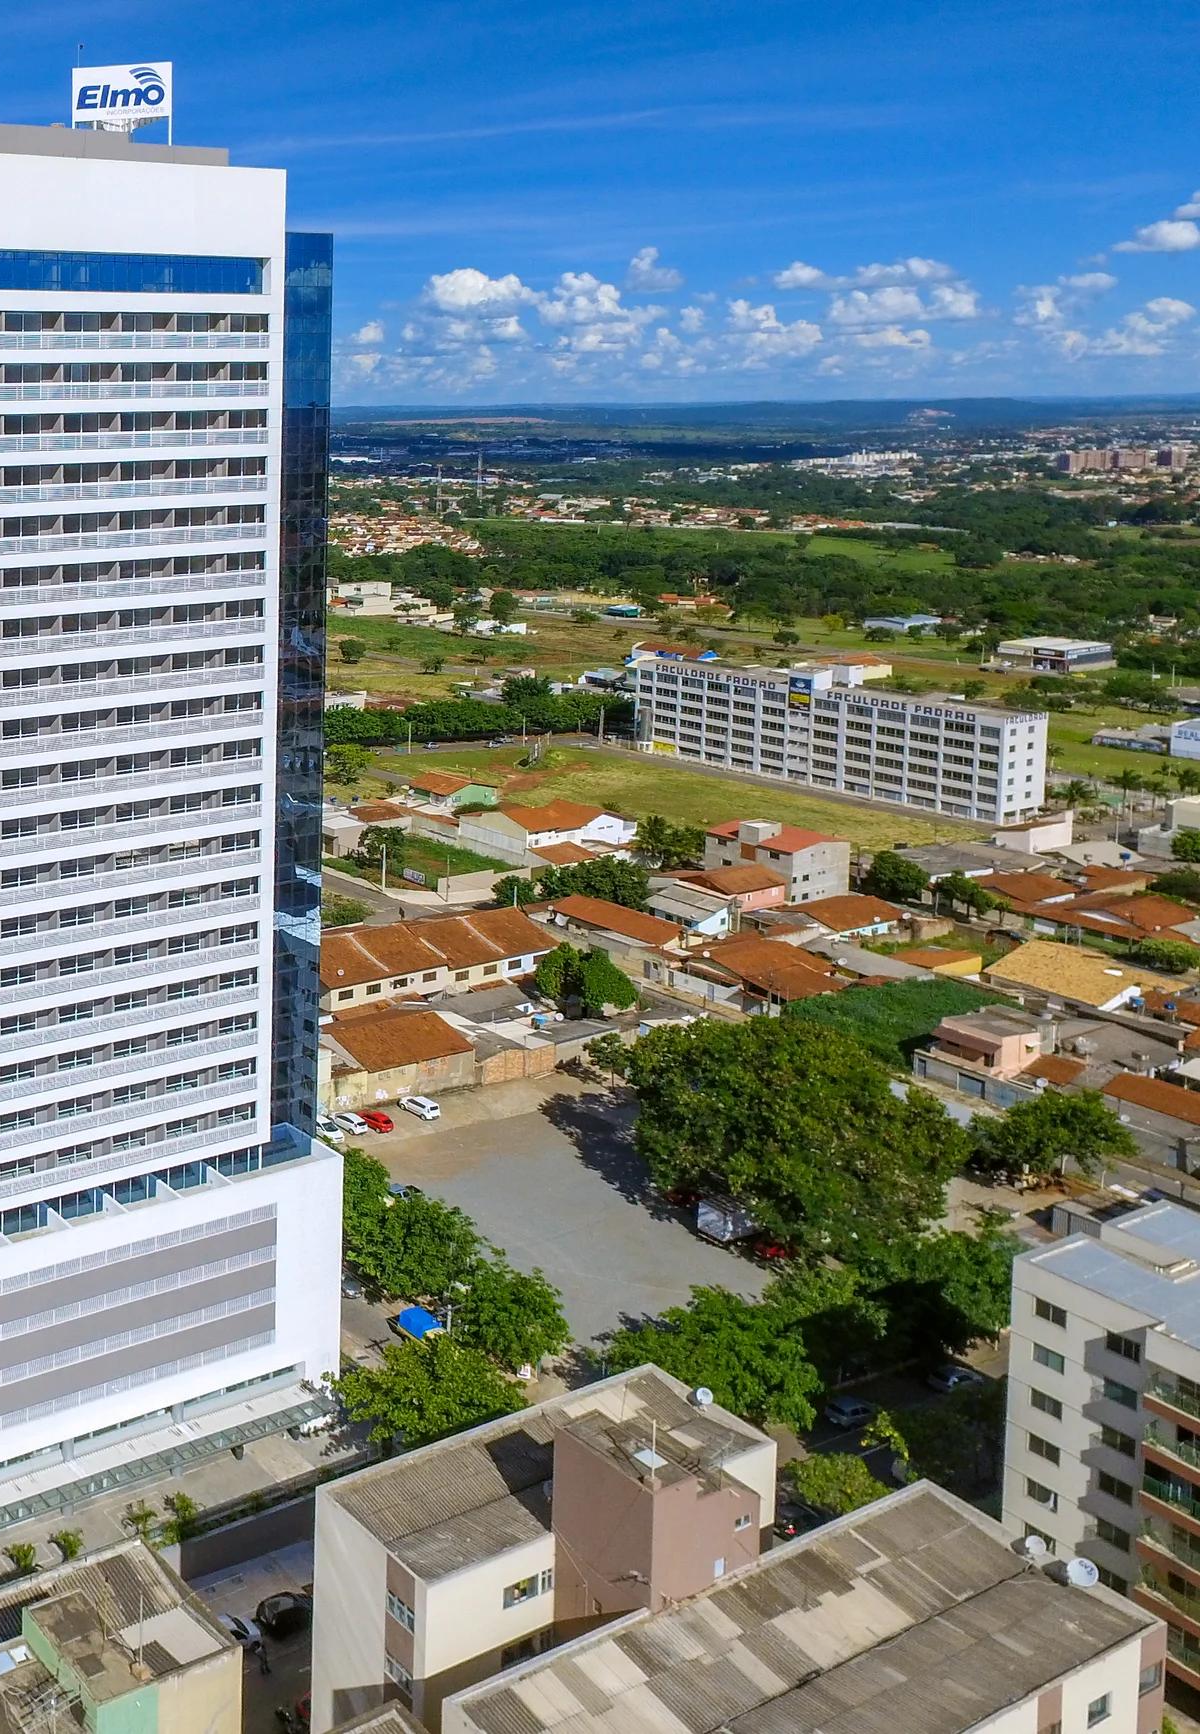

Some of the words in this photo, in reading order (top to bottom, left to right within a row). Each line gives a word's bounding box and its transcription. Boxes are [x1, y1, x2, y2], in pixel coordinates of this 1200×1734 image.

[76, 84, 165, 110] Elmo
[655, 663, 721, 682] FACULDADE
[827, 691, 907, 711] FACULDADE
[1005, 712, 1047, 725] FACULDADE
